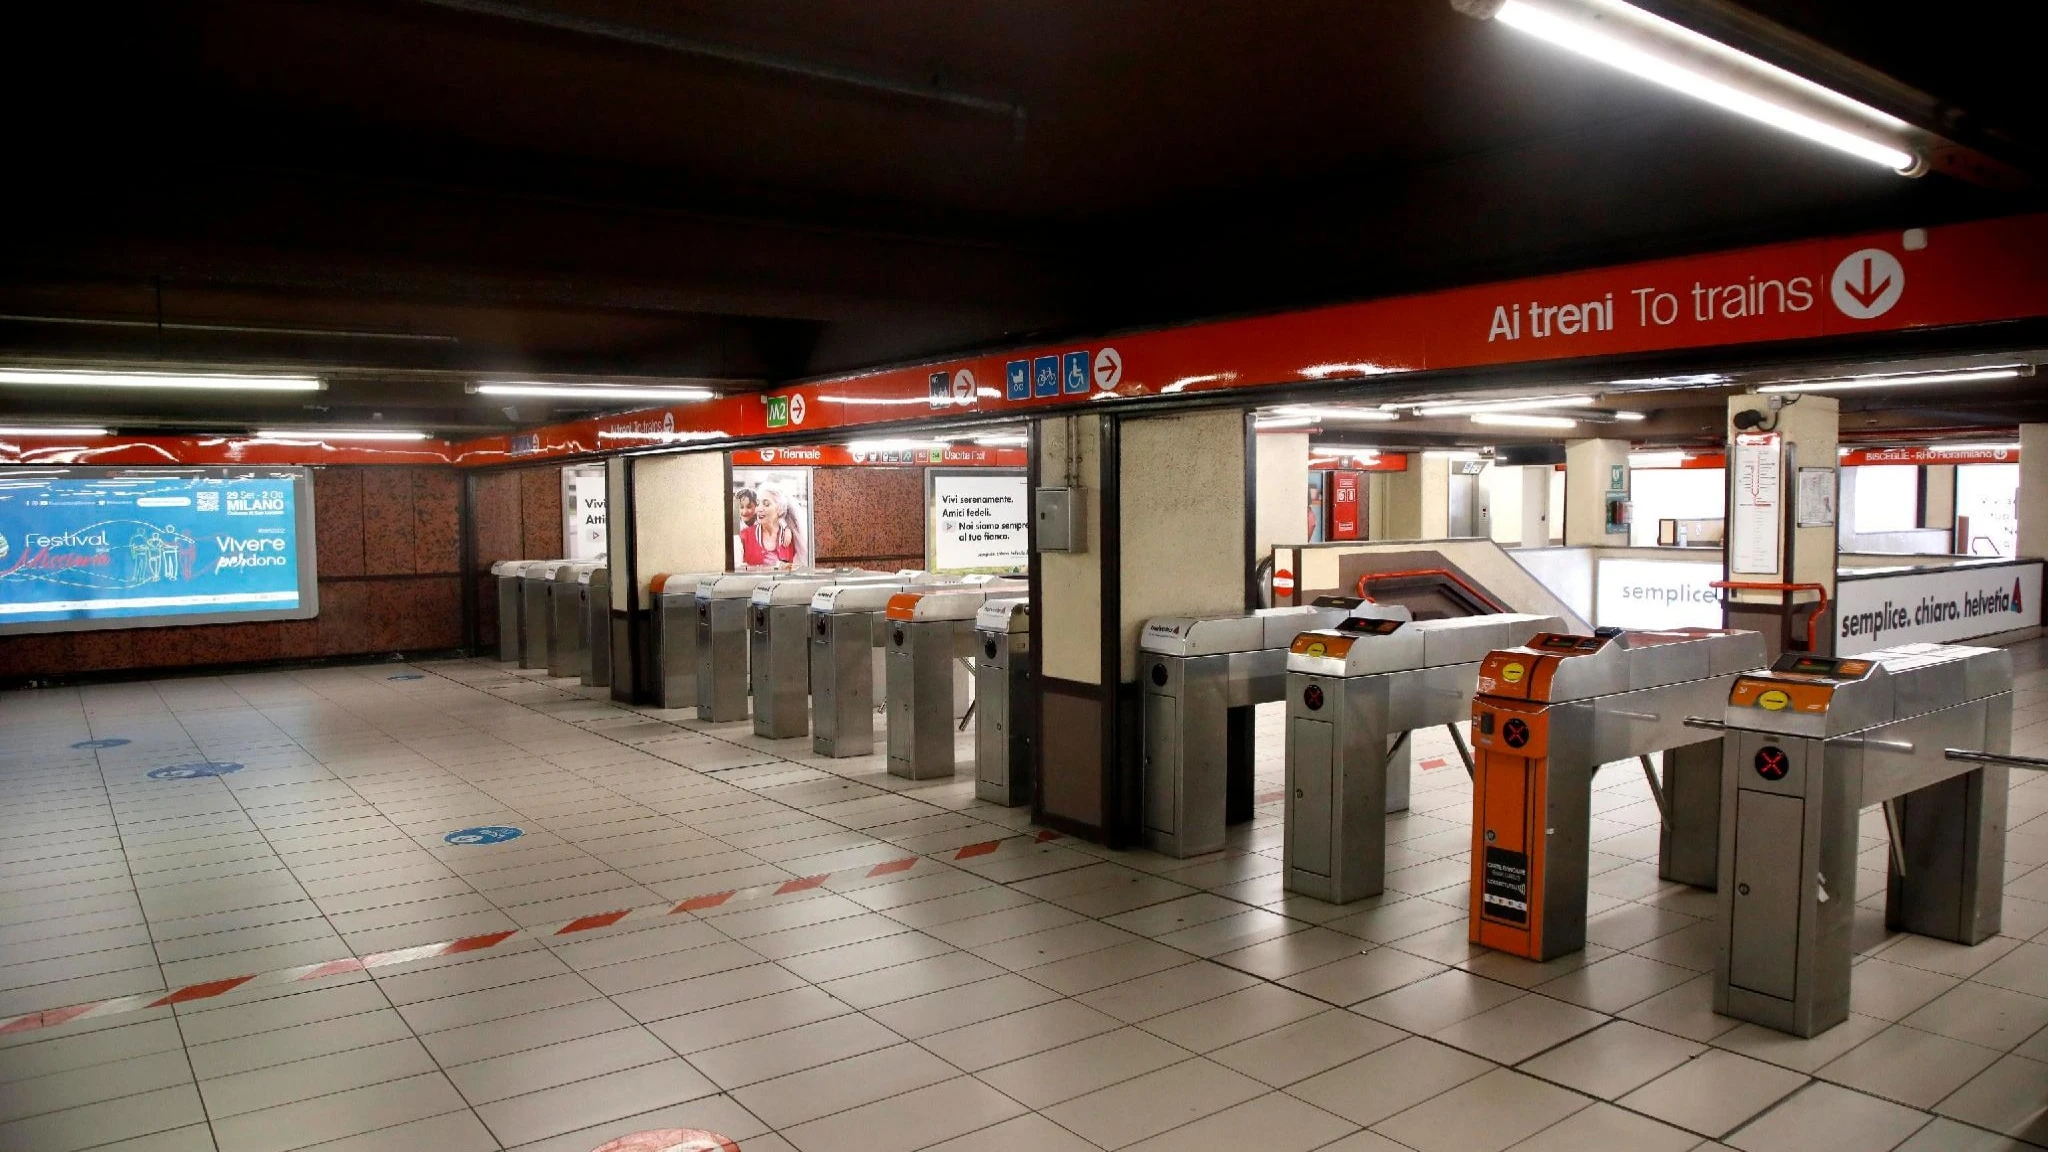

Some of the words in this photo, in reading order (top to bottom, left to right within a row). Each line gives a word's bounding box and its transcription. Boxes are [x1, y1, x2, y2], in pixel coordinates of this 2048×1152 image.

[1487, 301, 1521, 342] Ai
[1528, 292, 1614, 338] treni
[1631, 286, 1679, 327] To
[1691, 274, 1815, 321] trains
[768, 402, 787, 421] M2
[777, 449, 821, 460] Triennale
[1865, 450, 1910, 461] BISCEGLIE
[1916, 451, 1937, 460] RHO
[226, 491, 239, 500] 29
[262, 490, 268, 499] 2
[942, 494, 958, 504] Vivi
[960, 495, 1014, 504] serenamente.
[226, 499, 284, 511] MILANO
[585, 498, 607, 508] Vivi
[942, 508, 965, 517] Amici
[966, 507, 992, 517] fedeli.
[958, 521, 974, 530] Noi
[976, 521, 999, 530] siamo
[1001, 522, 1029, 531] sempre
[26, 531, 110, 549] Festival
[958, 532, 967, 542] al
[968, 533, 982, 541] tuo
[984, 531, 1010, 541] fianco.
[216, 536, 286, 552] Vivere
[1841, 601, 1911, 641] semplice.
[1914, 595, 1960, 626] chiaro.
[1964, 586, 2010, 618] helvetia
